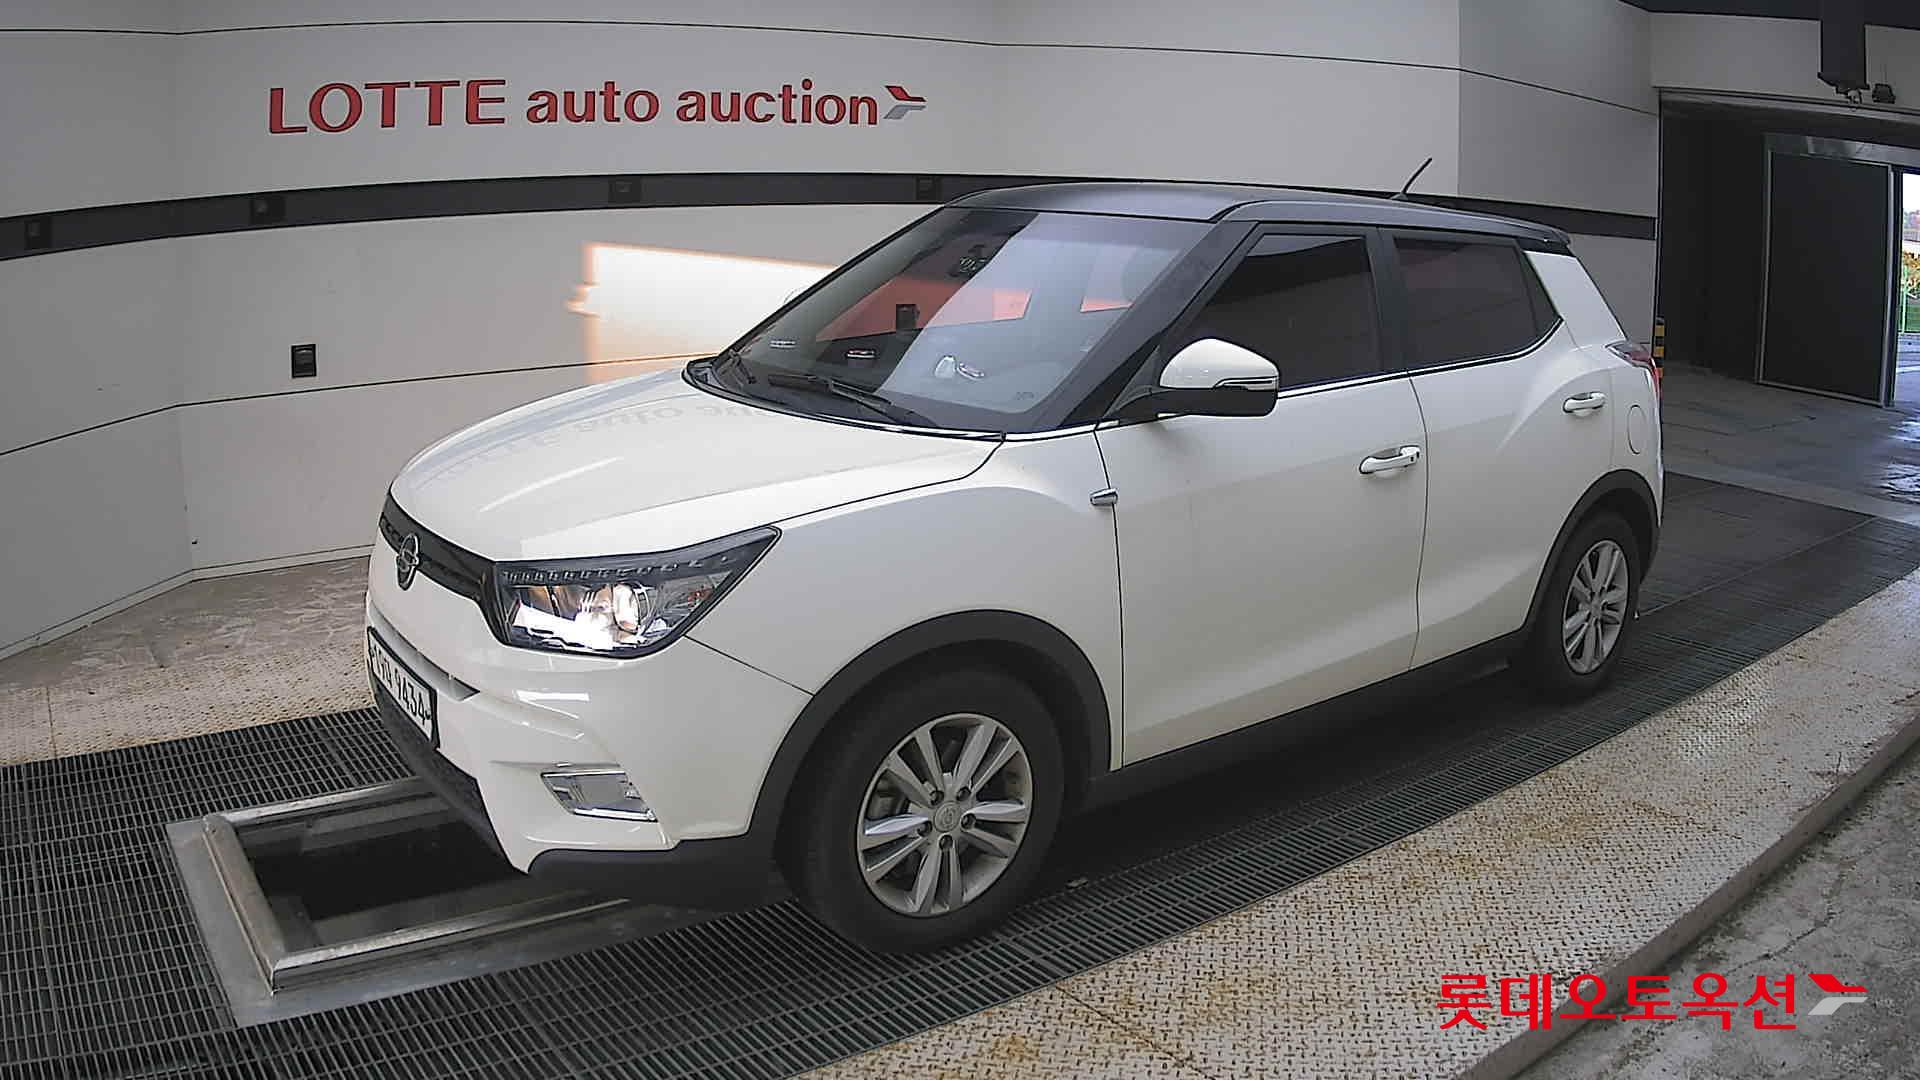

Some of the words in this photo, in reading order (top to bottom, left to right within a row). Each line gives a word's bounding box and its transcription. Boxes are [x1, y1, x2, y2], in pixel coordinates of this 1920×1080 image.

[269, 79, 506, 134] LOTTE
[526, 81, 659, 123] auto
[676, 78, 878, 125] auction
